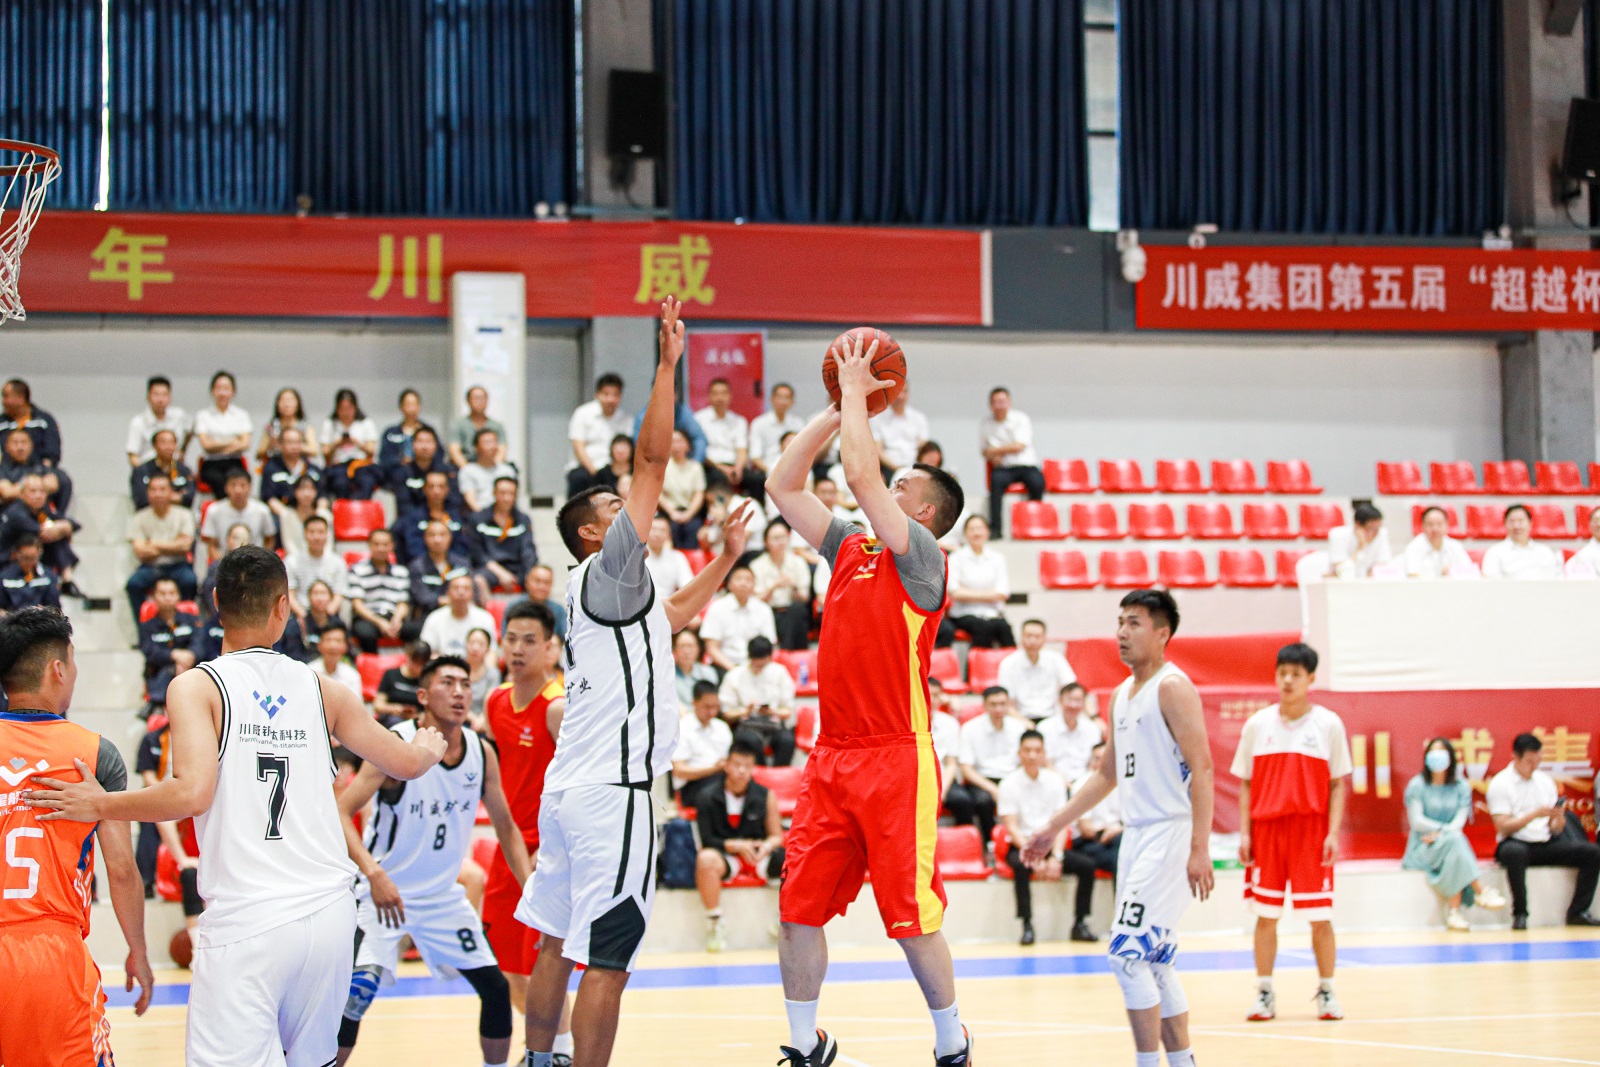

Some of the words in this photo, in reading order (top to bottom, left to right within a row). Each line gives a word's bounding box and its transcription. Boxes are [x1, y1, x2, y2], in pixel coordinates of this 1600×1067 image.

[1162, 261, 1447, 313] 川威集团第五届
[1124, 753, 1136, 778] 13
[257, 751, 290, 840] 7
[432, 823, 447, 851] 8
[1118, 901, 1145, 928] 13
[457, 928, 477, 953] 8
